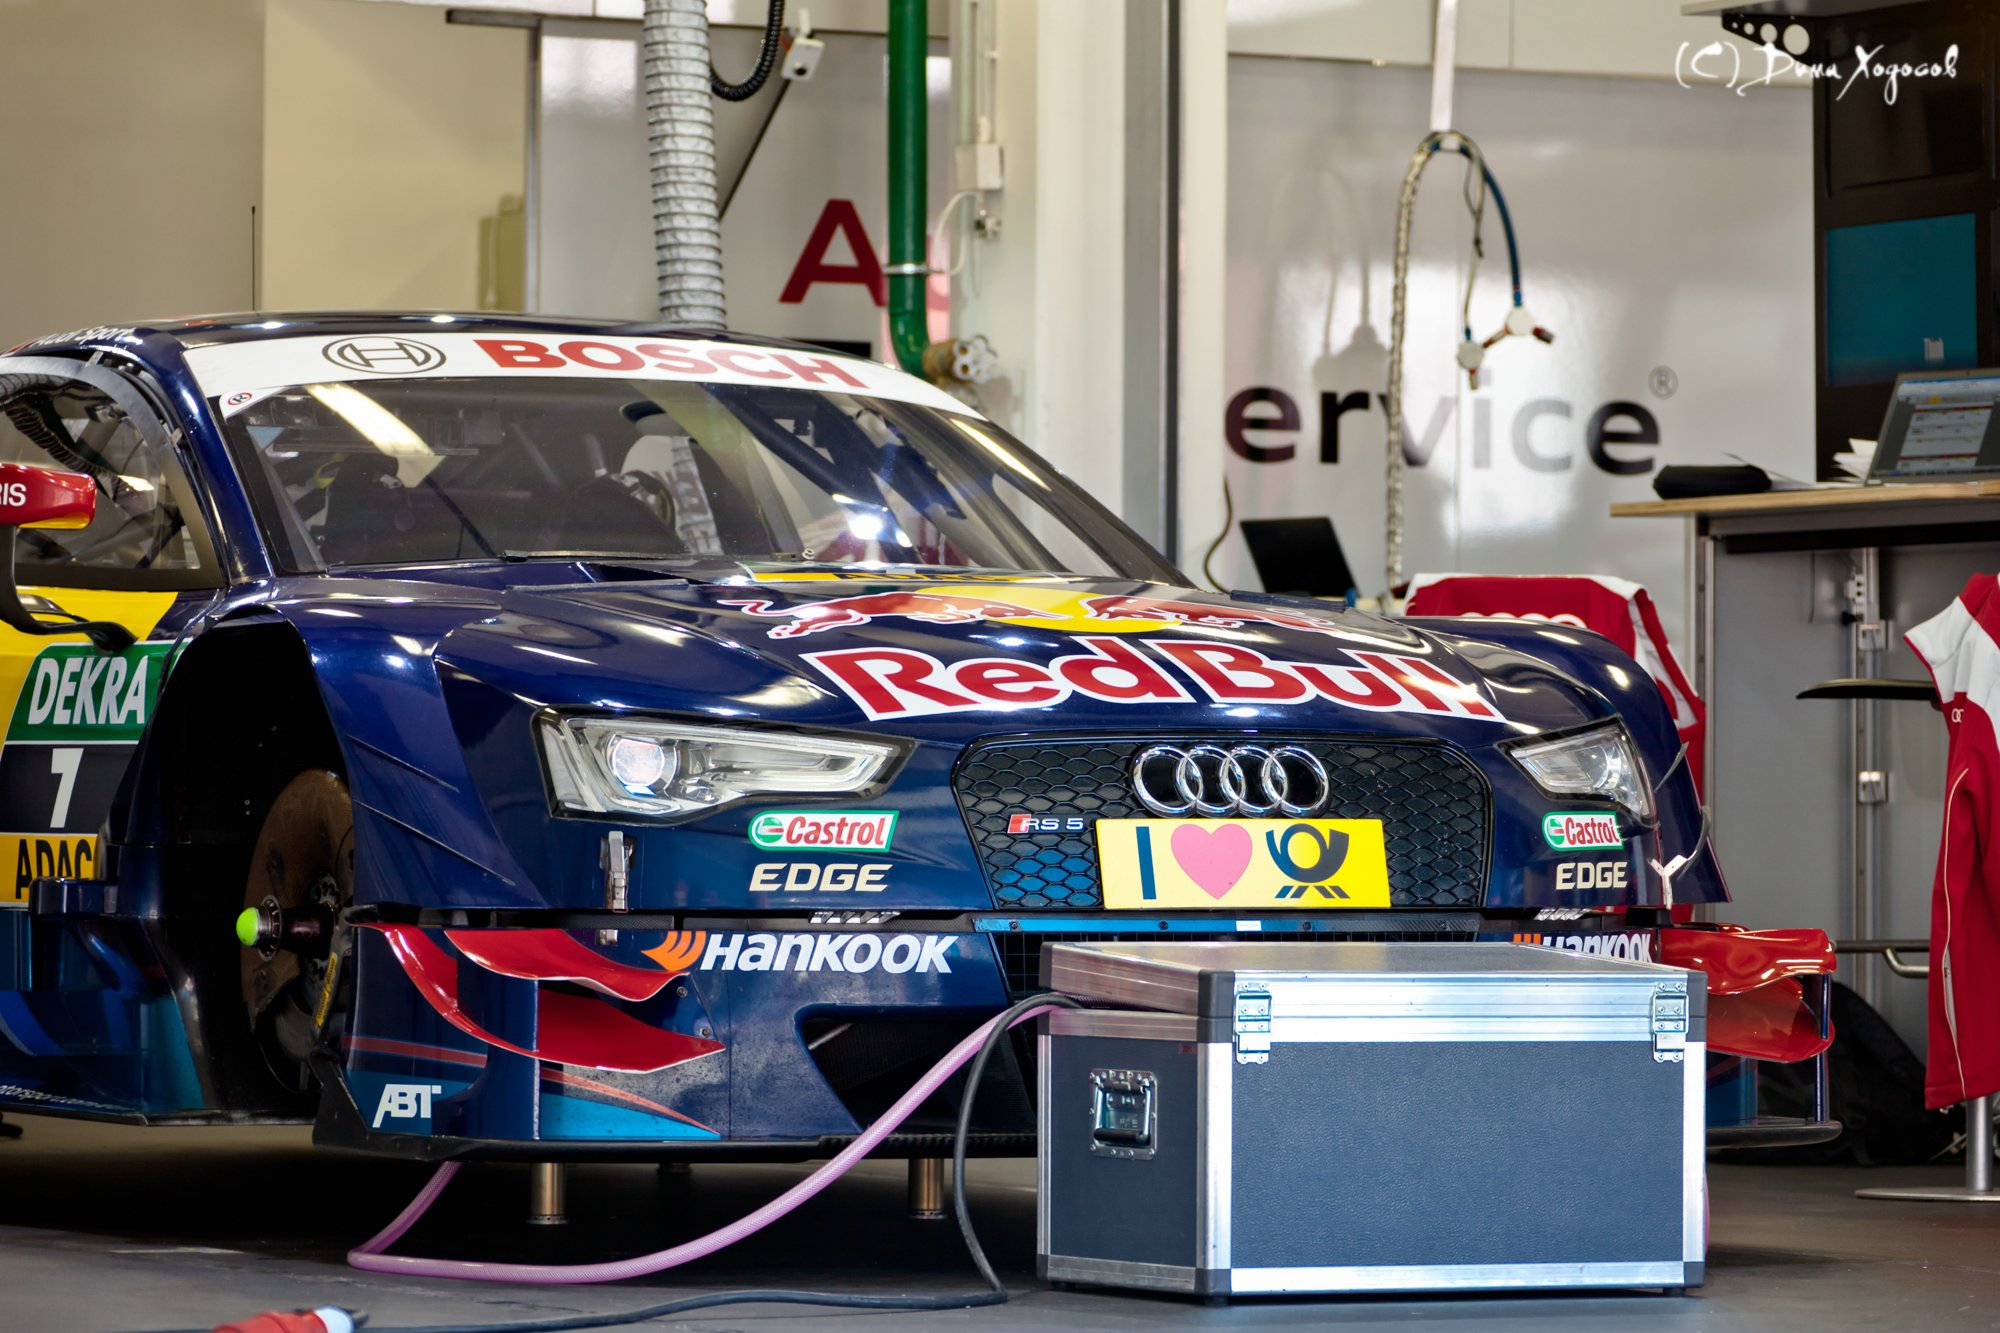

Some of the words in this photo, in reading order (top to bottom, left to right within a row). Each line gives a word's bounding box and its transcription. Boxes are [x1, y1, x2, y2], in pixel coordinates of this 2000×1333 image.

[473, 339, 870, 389] BOSCH
[0, 482, 27, 507] IS
[28, 655, 148, 725] DEKRA
[50, 748, 84, 828] 1
[785, 816, 886, 846] Castrol
[1020, 817, 1060, 832] RS
[1065, 817, 1085, 831] 5
[1565, 817, 1621, 846] Castrol
[15, 838, 92, 900] ADAC
[749, 863, 893, 892] EDGE
[1135, 826, 1157, 900] I
[1555, 861, 1628, 890] EDGE
[372, 1084, 442, 1129] ABT
